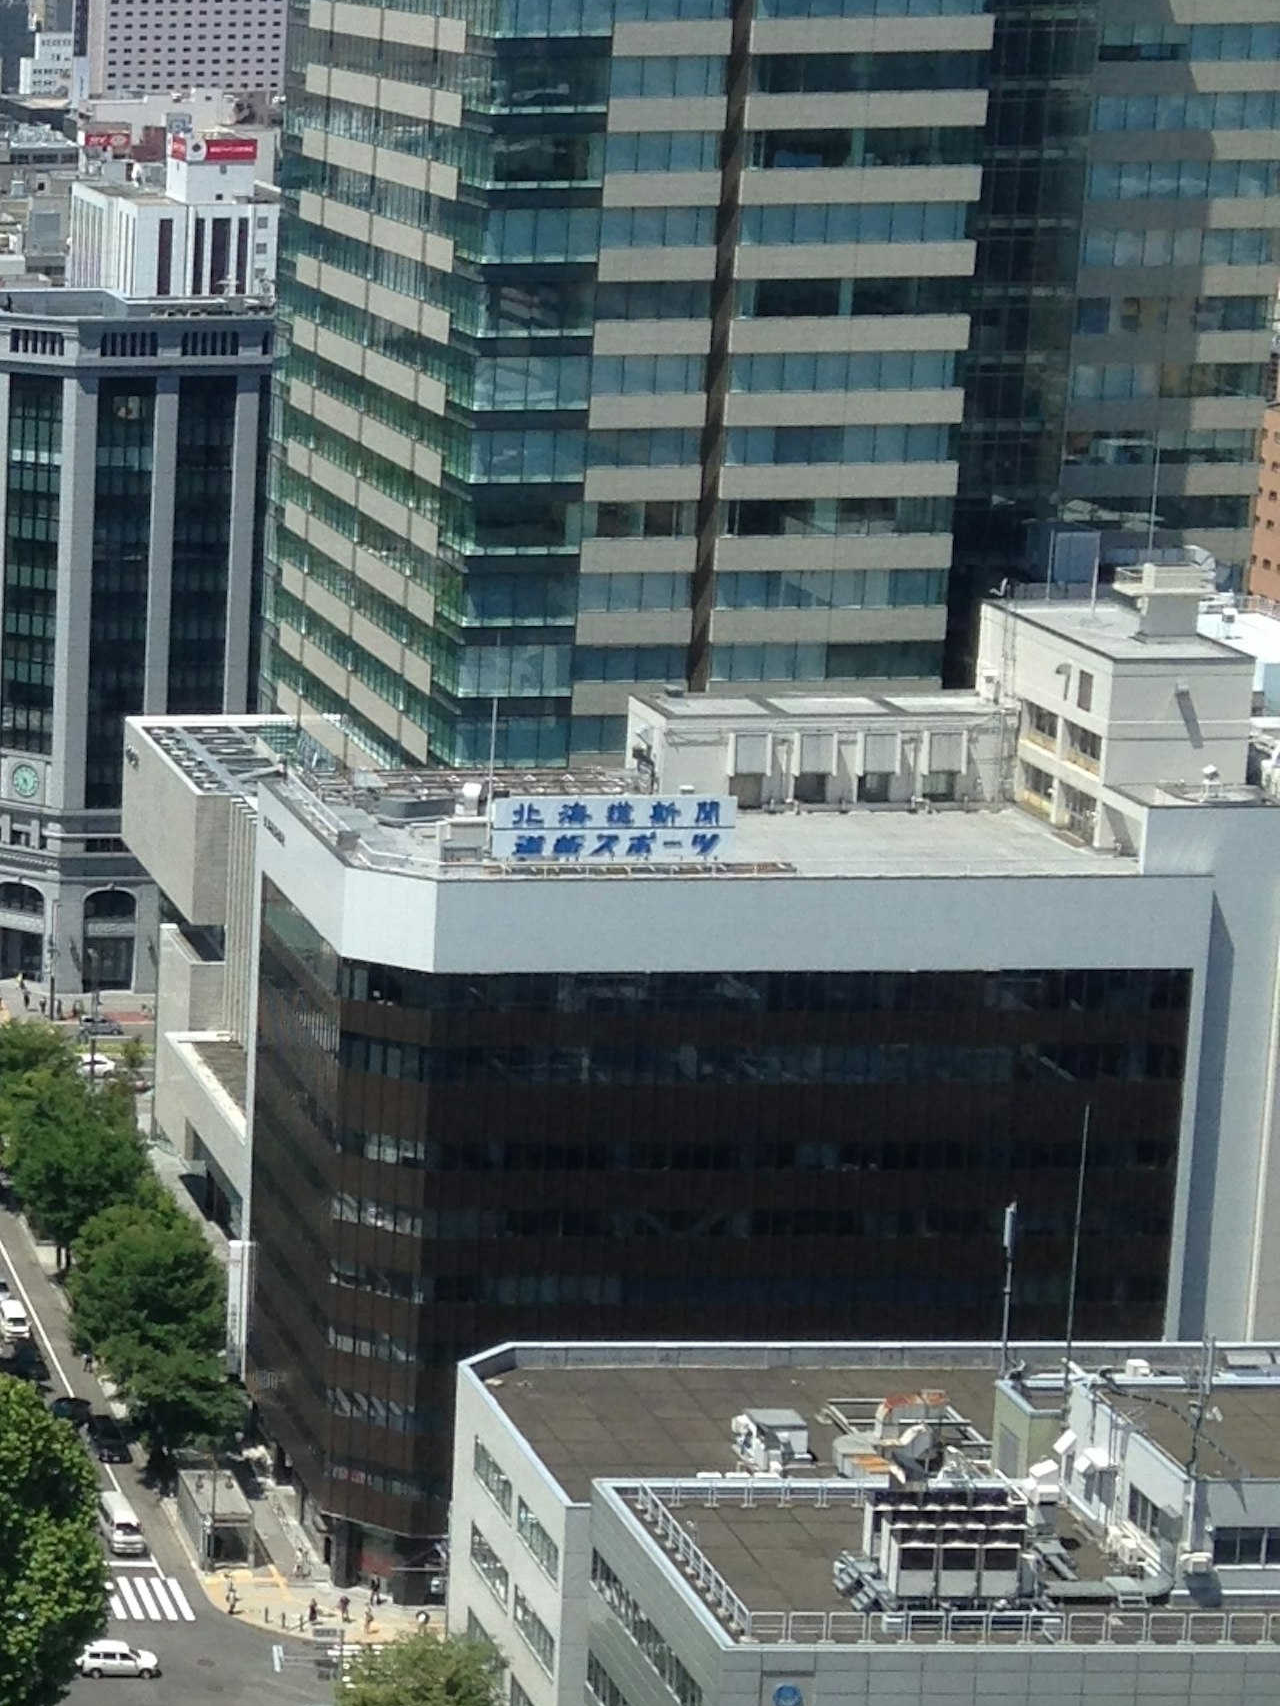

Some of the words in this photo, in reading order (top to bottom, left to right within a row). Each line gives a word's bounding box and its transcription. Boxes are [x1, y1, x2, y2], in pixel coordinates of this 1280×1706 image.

[512, 801, 721, 827] 北海道新聞
